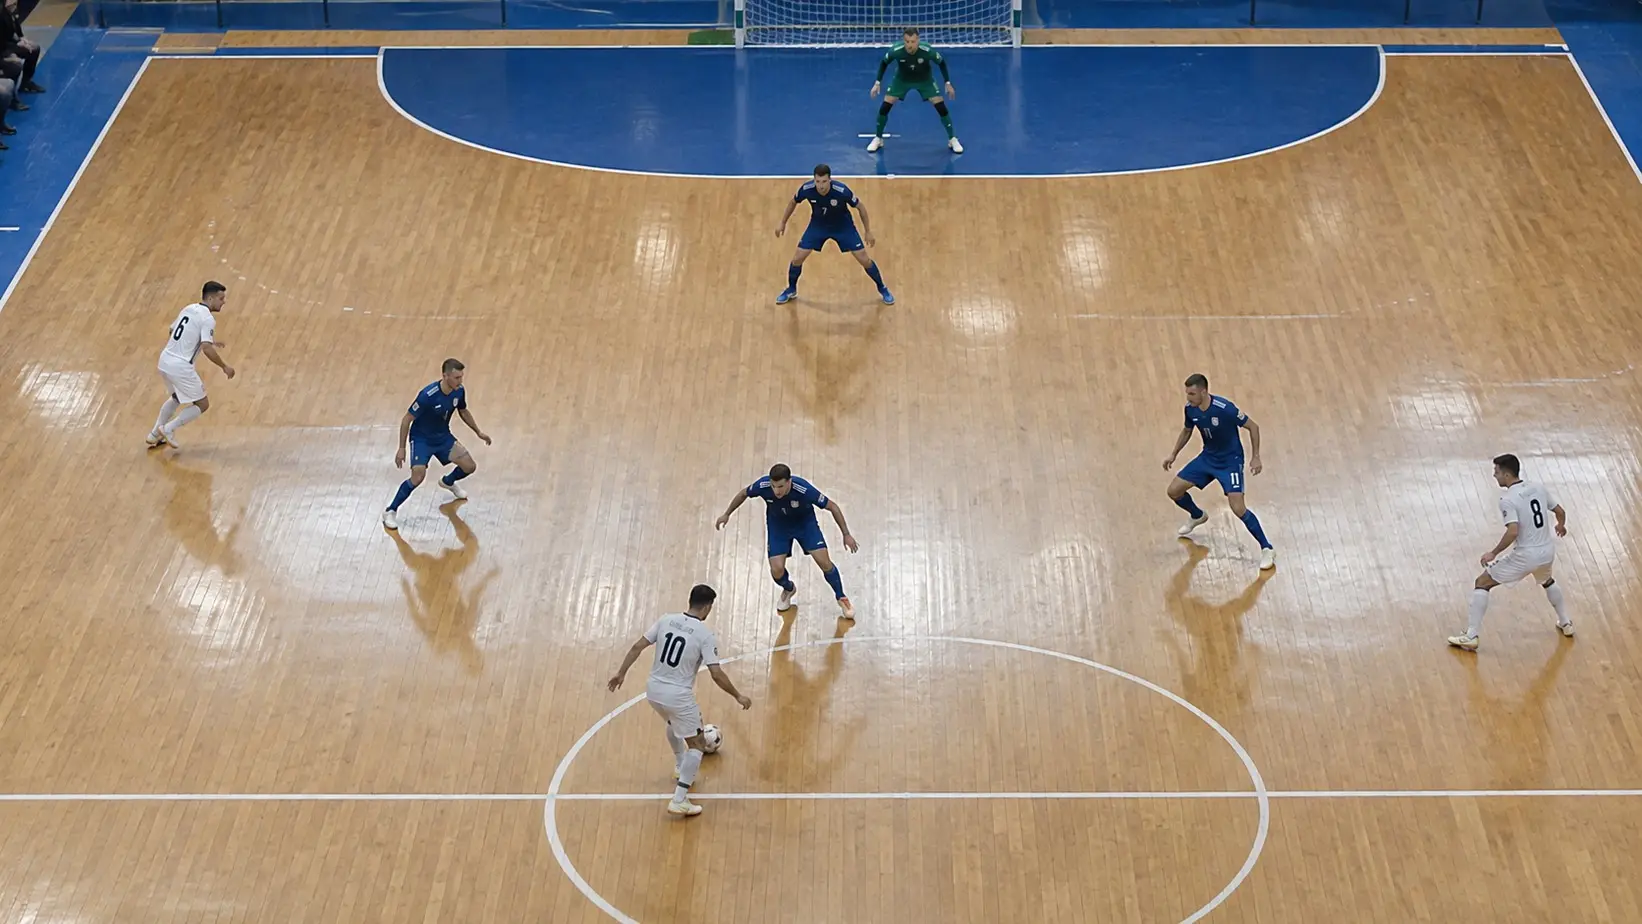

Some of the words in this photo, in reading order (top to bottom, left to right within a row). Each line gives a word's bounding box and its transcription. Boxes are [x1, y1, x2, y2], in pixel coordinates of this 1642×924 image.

[821, 206, 828, 216] 7
[173, 315, 190, 341] 6
[1230, 472, 1240, 485] 11
[1530, 498, 1544, 529] 8
[659, 632, 687, 669] 10
